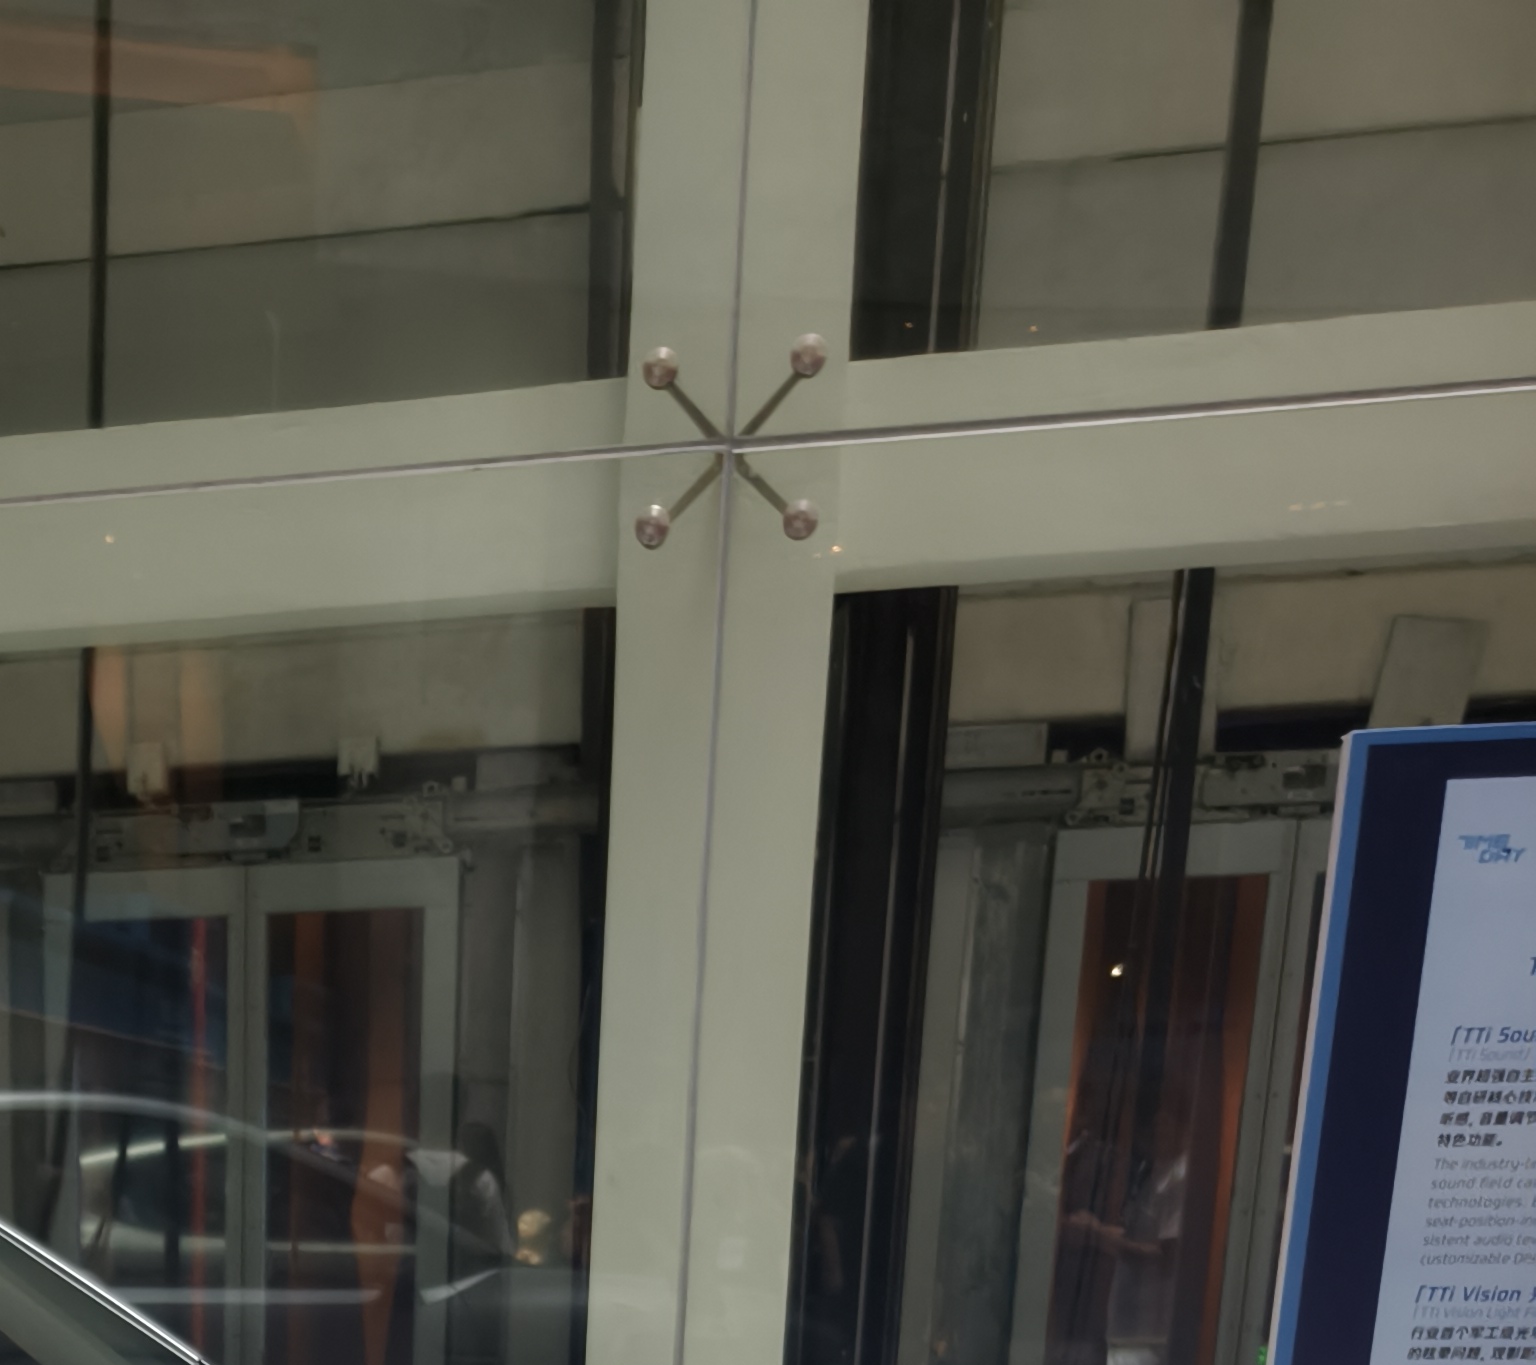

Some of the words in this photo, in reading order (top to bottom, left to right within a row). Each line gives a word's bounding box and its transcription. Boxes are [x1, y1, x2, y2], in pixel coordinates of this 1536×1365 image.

[1497, 1026, 1536, 1044] Sou
[1463, 1284, 1522, 1302] Vision
[1410, 1325, 1536, 1340] 行业首个军工级光
